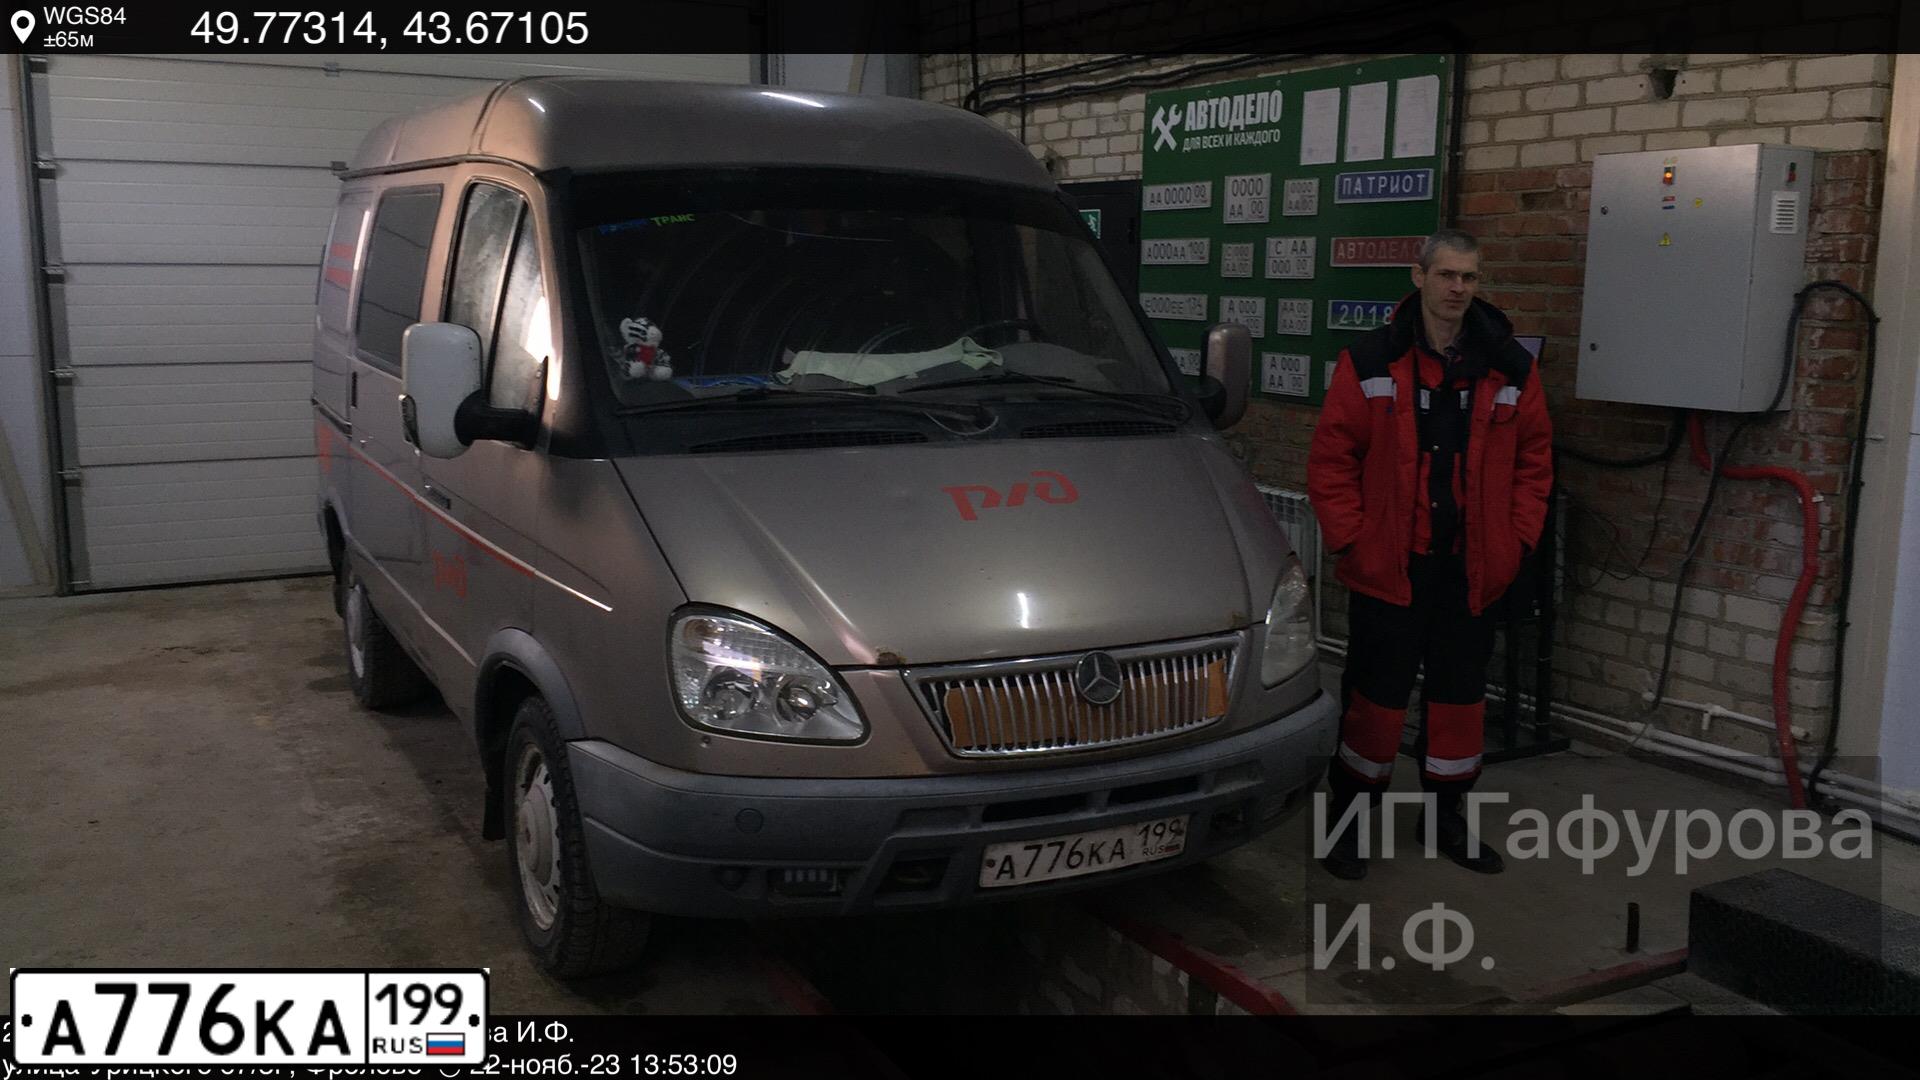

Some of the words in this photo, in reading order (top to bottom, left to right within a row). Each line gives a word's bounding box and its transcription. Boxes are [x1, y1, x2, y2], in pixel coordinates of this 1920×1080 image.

[1184, 89, 1283, 132] АВТОДЕЛО
[1182, 137, 1201, 152] ДЛЯ
[1202, 134, 1226, 149] ВСЕХ
[1225, 133, 1233, 147] И
[1233, 128, 1281, 147] КАЖДОГО
[1231, 177, 1264, 197] 0000
[1342, 173, 1427, 195] ПАТРИОТ
[1250, 199, 1264, 215] 00
[996, 837, 1125, 880] А776КА
[1142, 845, 1165, 857] RUS
